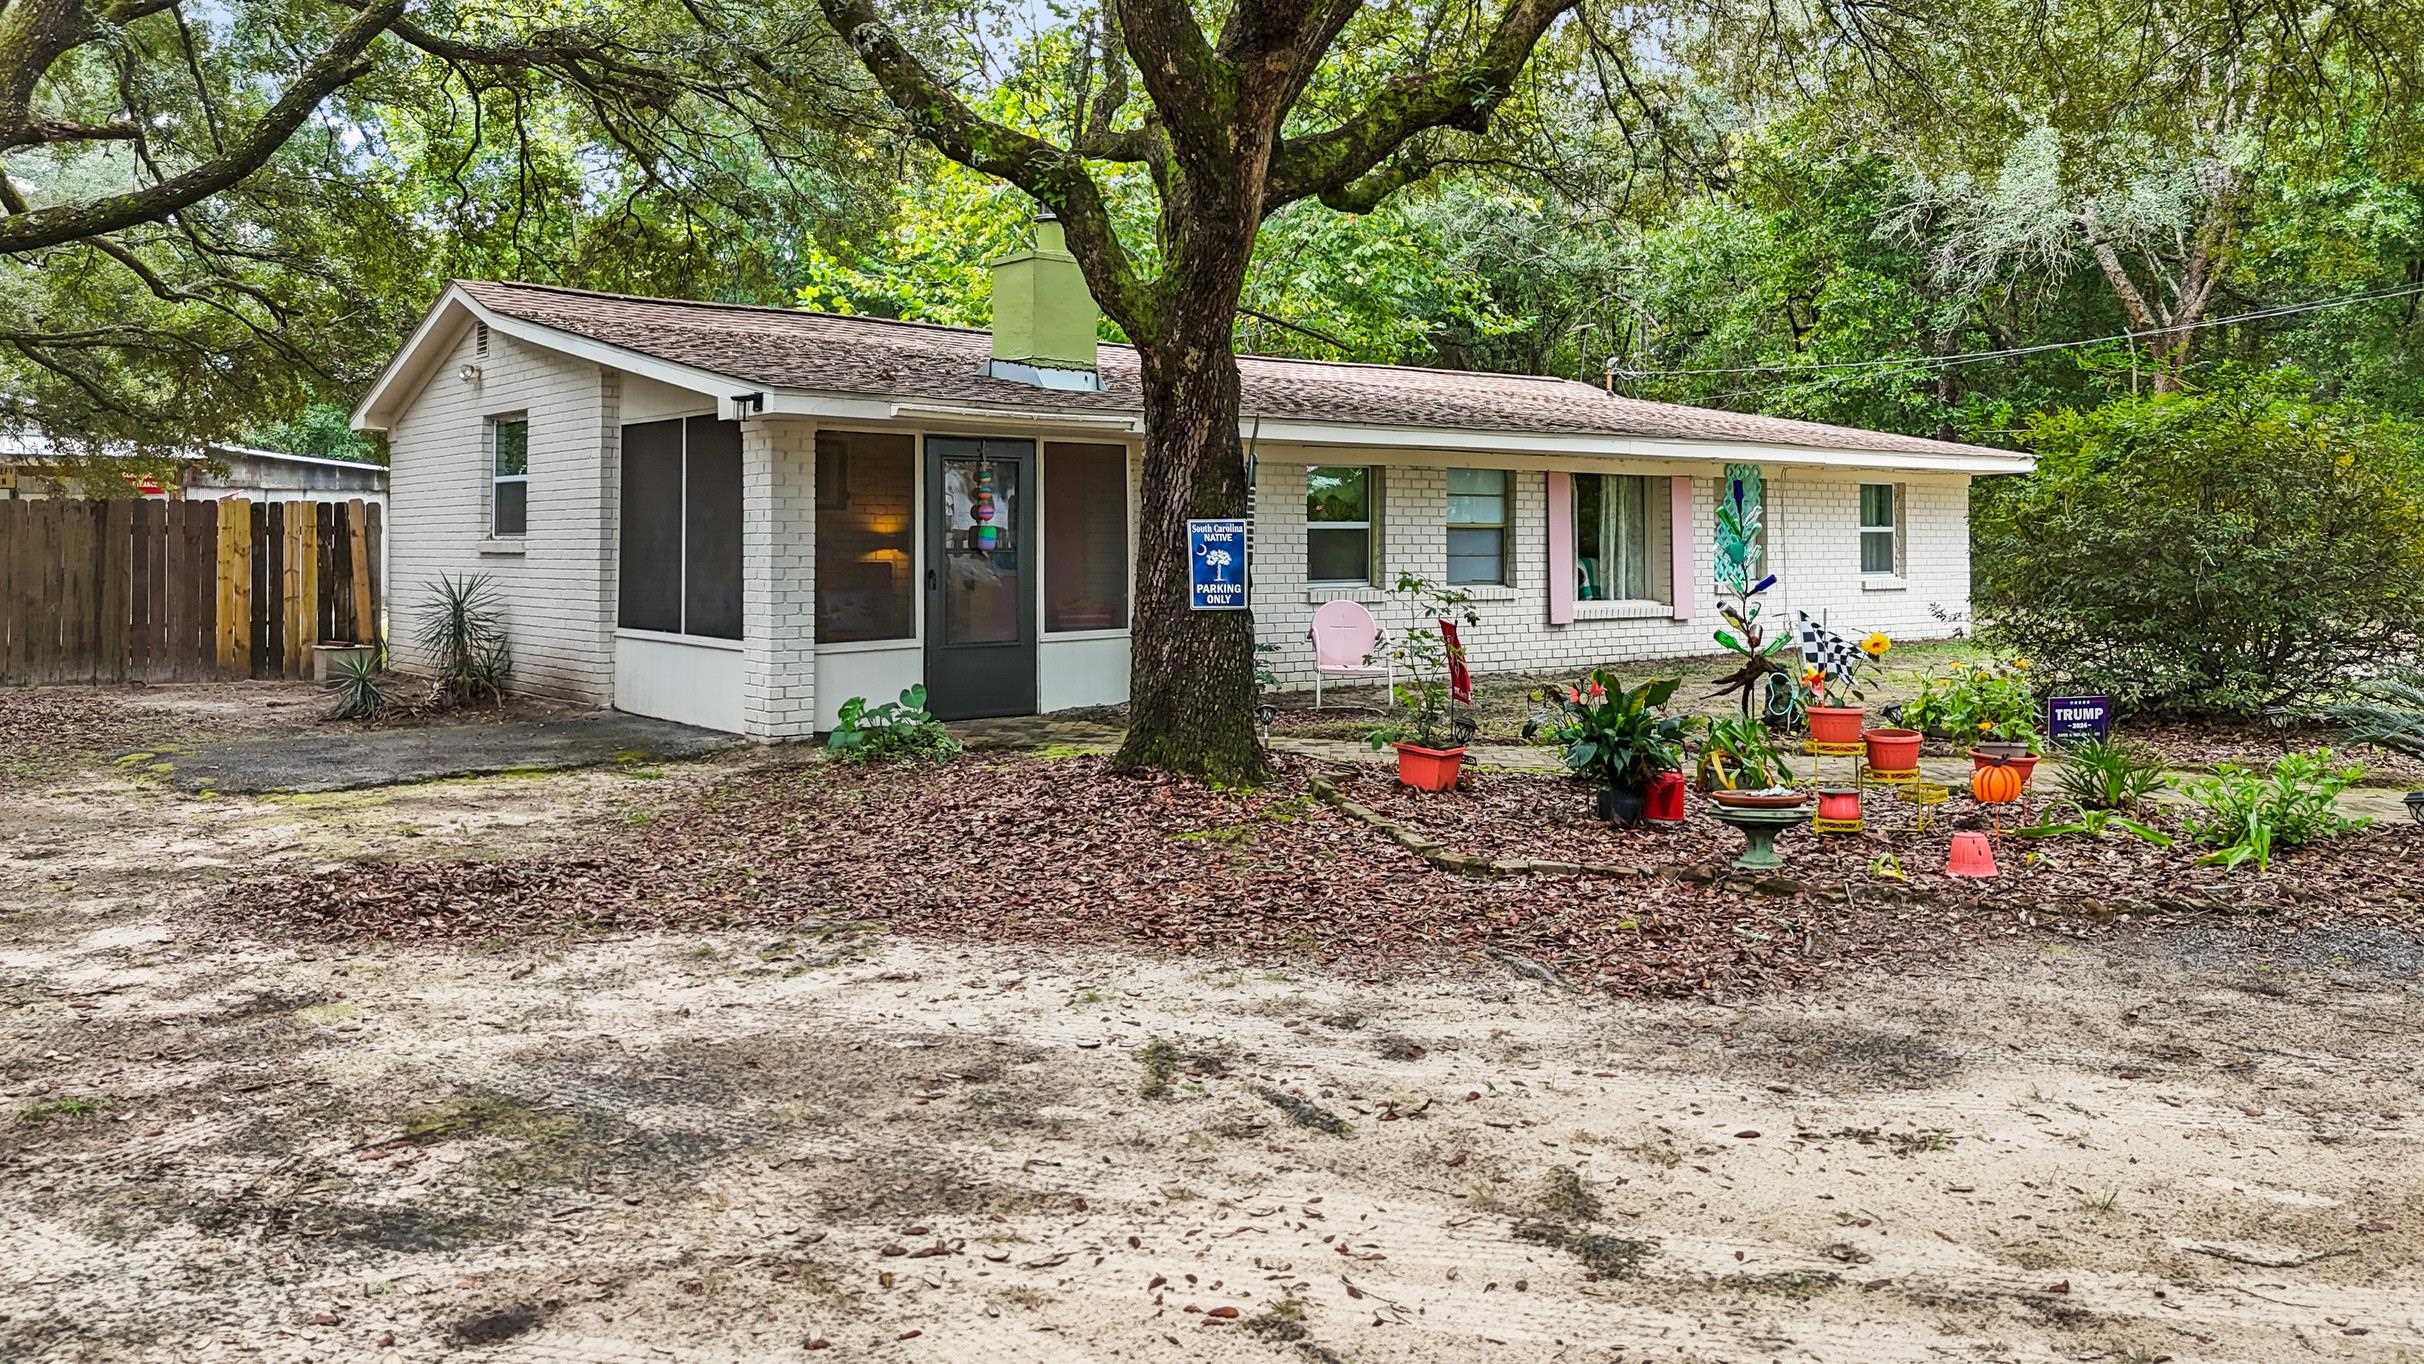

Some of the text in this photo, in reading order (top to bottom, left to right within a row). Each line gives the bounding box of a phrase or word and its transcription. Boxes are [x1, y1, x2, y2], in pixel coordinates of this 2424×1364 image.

[1192, 524, 1243, 533] South Carolina
[1204, 534, 1233, 542] NATIVE
[1197, 584, 1242, 593] PARKING
[1207, 594, 1232, 604] ONLY
[2055, 707, 2104, 721] TRUMP
